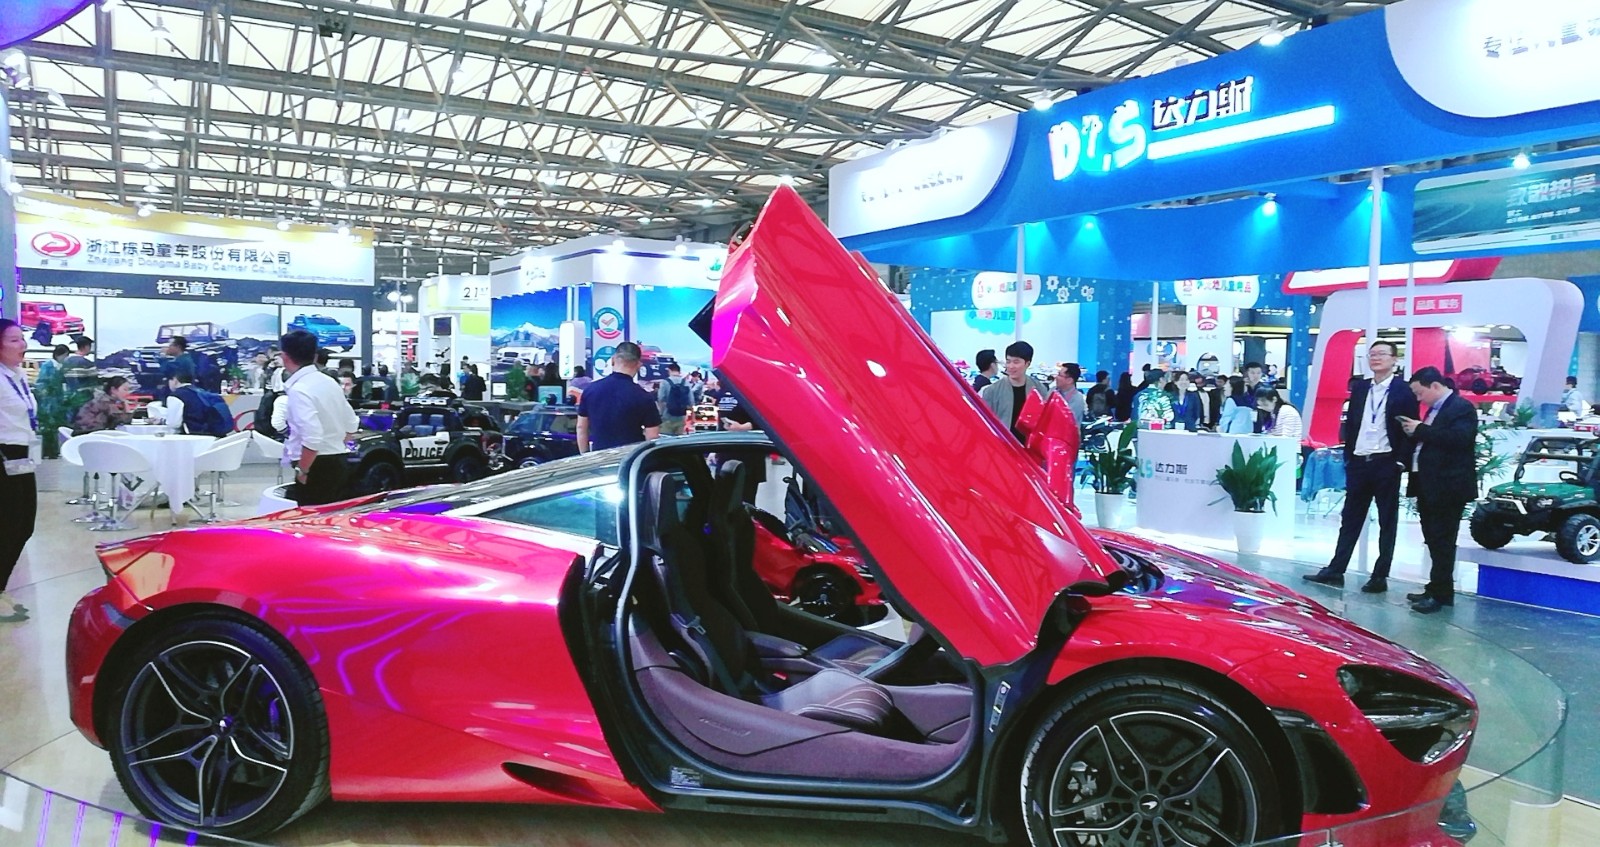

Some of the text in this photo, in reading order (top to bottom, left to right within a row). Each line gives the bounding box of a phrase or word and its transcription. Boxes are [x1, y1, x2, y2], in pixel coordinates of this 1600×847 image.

[1151, 75, 1254, 132] 达力斯
[86, 238, 291, 265] 浙江栋马童车股份有限公司
[138, 256, 181, 269] Dongma
[156, 279, 221, 297] 栋马童车
[404, 447, 444, 458] POLICE
[1155, 462, 1188, 475] 达力斯
